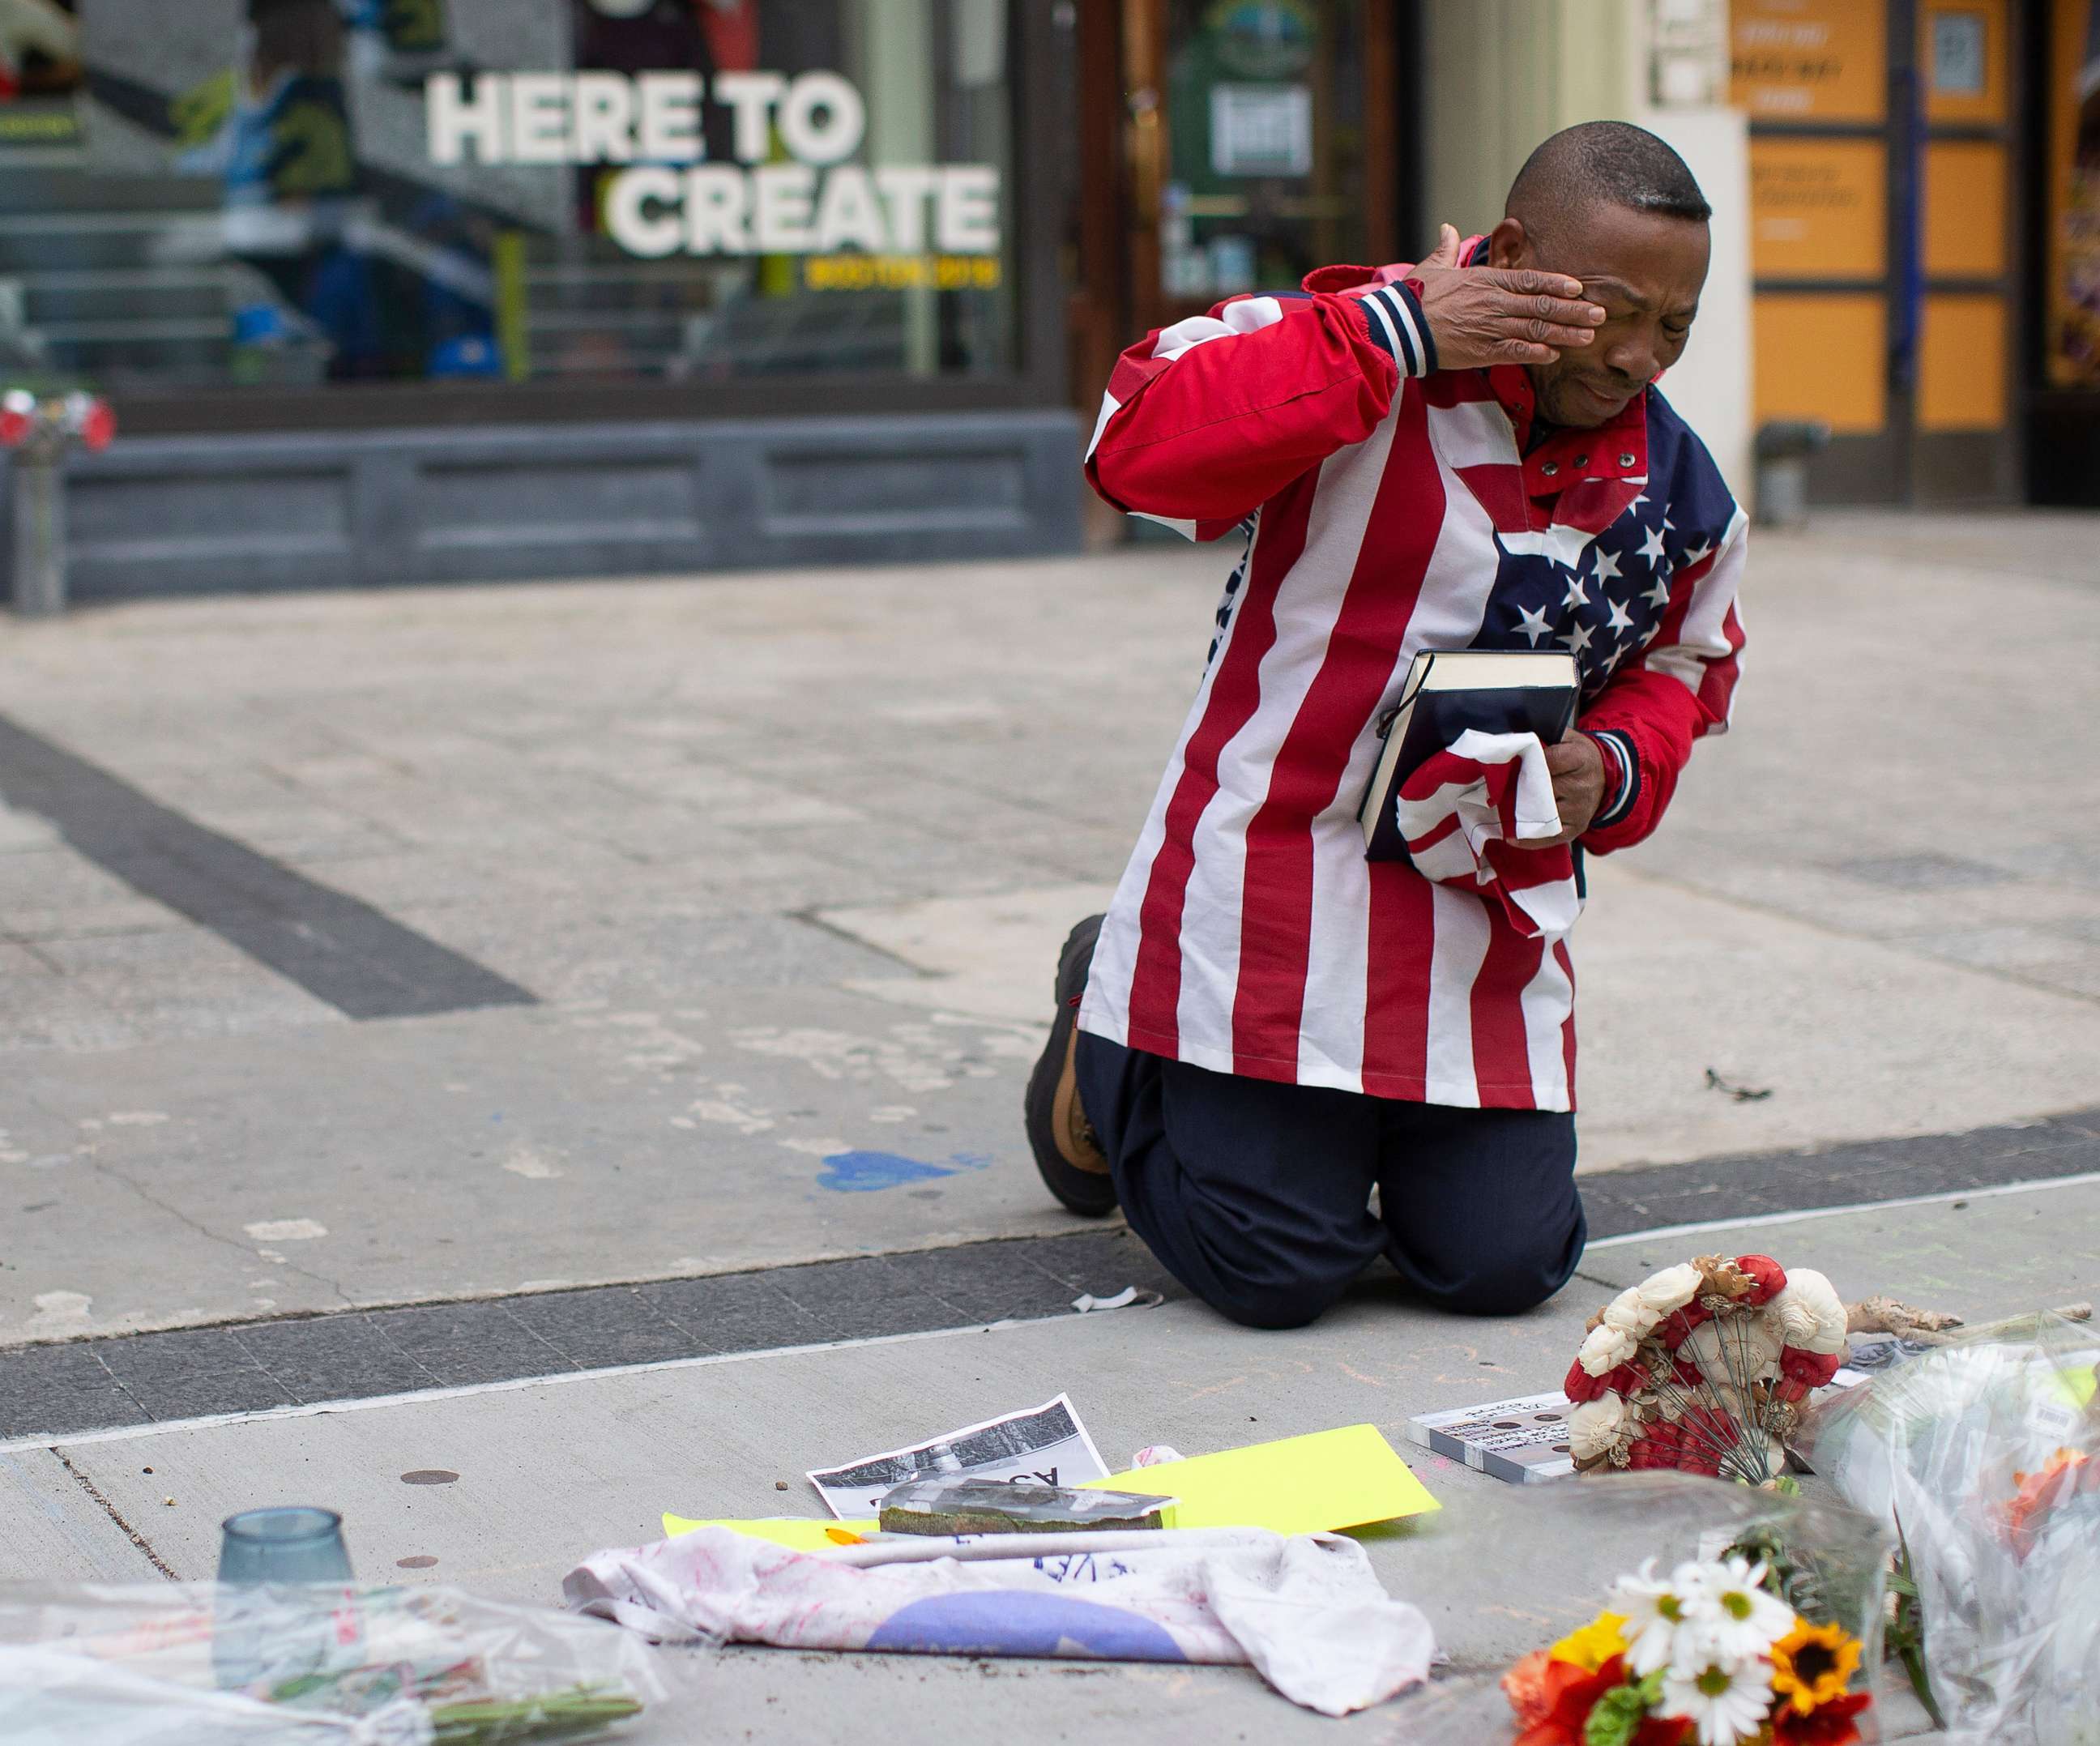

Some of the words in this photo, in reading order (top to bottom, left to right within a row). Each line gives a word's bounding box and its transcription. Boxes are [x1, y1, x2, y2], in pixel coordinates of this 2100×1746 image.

[426, 71, 704, 164] HERE
[716, 70, 864, 164] TO
[607, 164, 1000, 256] CREATE
